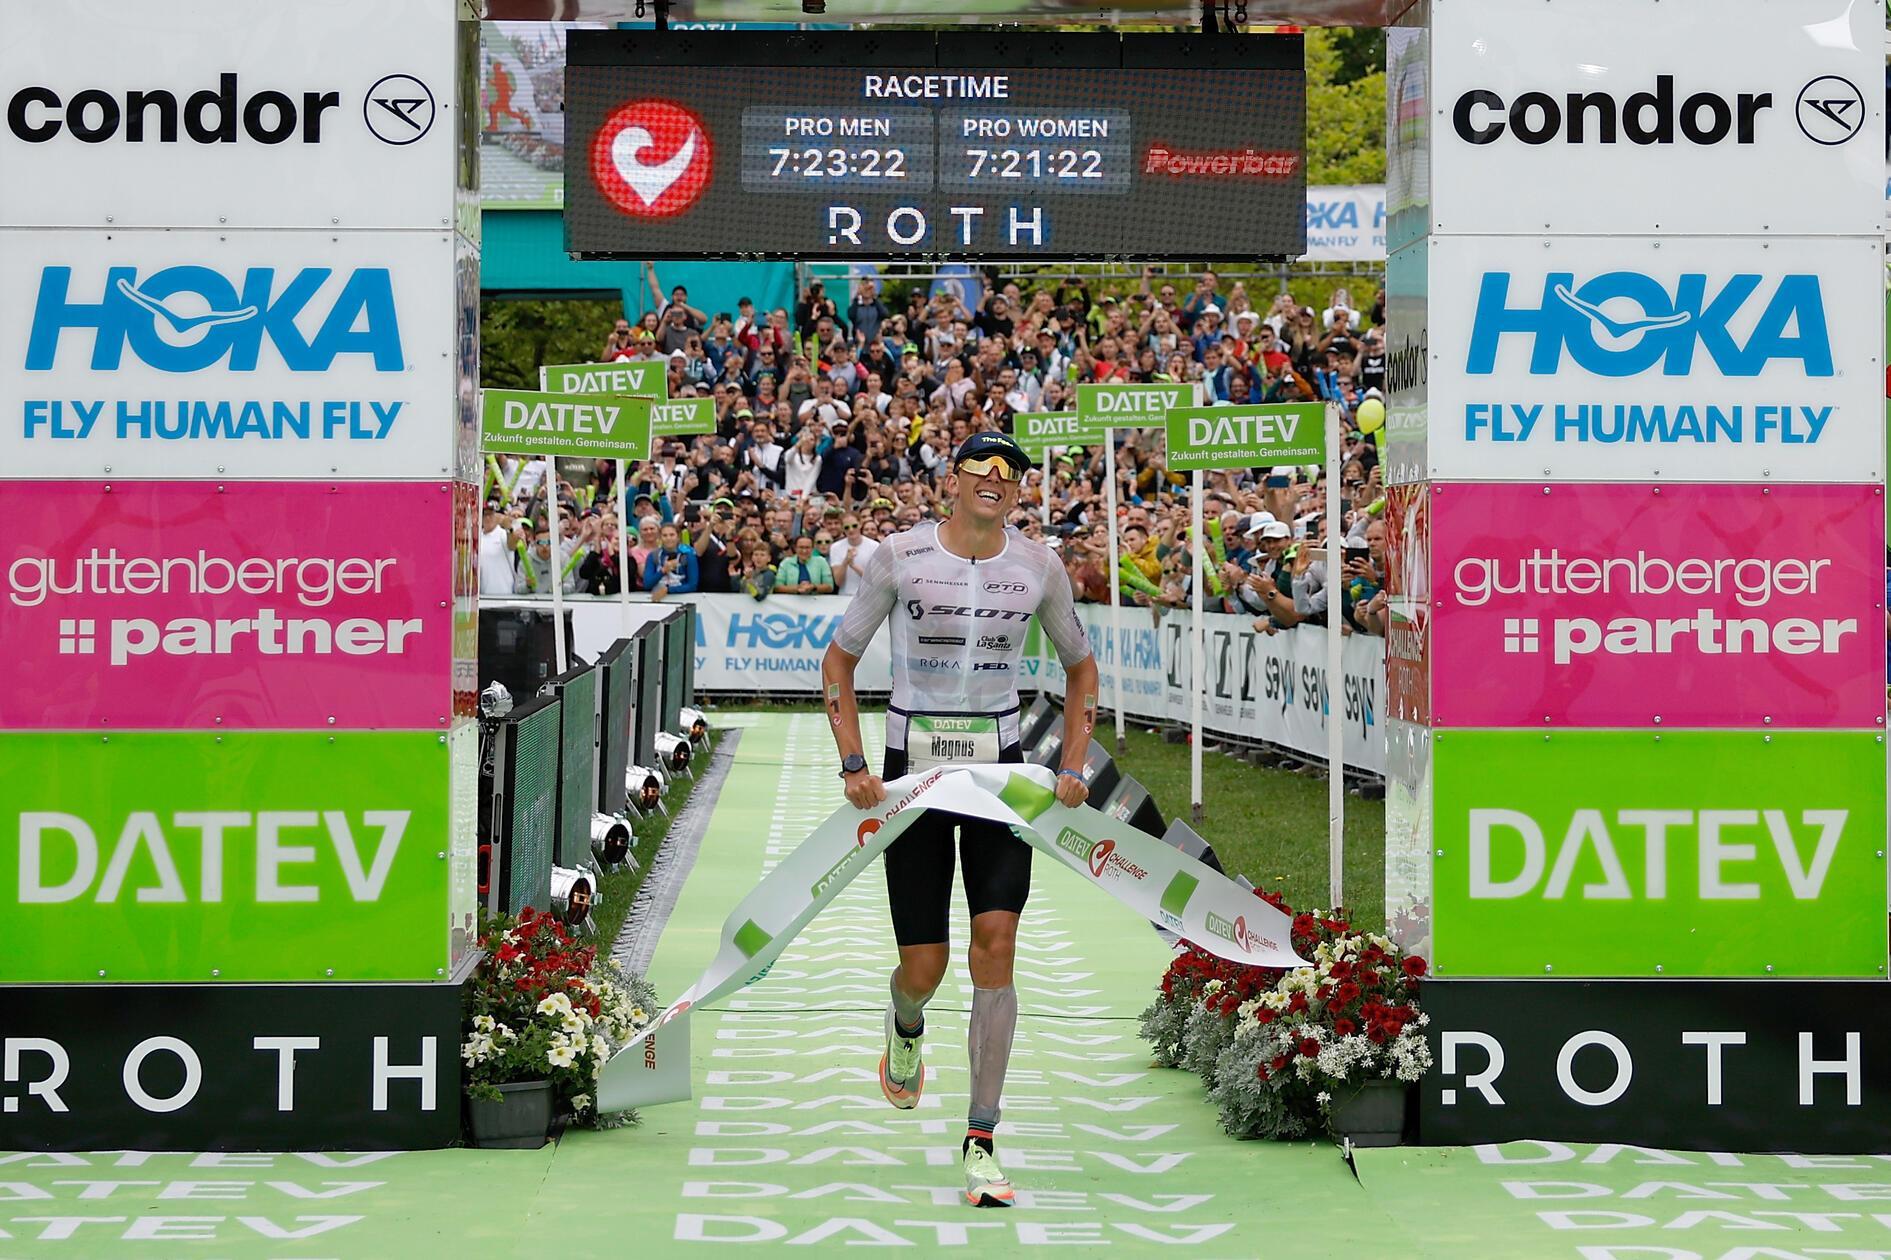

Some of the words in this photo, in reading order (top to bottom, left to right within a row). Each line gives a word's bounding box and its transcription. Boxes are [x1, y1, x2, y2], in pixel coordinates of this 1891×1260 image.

[865, 76, 1009, 98] RACETIME
[6, 73, 340, 145] condor
[1453, 75, 1772, 145] condor
[786, 118, 833, 136] PRO
[840, 119, 890, 136] MEN
[964, 120, 1010, 137] PRO
[1018, 120, 1108, 137] WOMEN
[769, 149, 905, 177] 7:23:22
[967, 150, 1102, 178] 7:21:22
[1146, 149, 1298, 175] Powerbar
[829, 207, 1042, 245] ROTH
[24, 265, 405, 373] HOKA
[1466, 271, 1835, 377] HOKA
[563, 369, 645, 394] DATEV
[1096, 392, 1179, 412] DATEV
[24, 401, 104, 439] FLY
[116, 401, 310, 439] HUMAN
[323, 401, 402, 439] FLY
[503, 400, 621, 434] DATEV
[1188, 414, 1300, 446] DATEV
[1465, 404, 1543, 443] FLY
[1555, 404, 1742, 444] HUMAN
[1755, 406, 1833, 444] FLY
[483, 432, 523, 444] Zukunft
[525, 434, 575, 447] gestalten.
[576, 437, 639, 450] Gemeinsam.
[1171, 450, 1209, 461] Zukunft
[1211, 448, 1258, 460] gestalten.
[1260, 446, 1320, 458] Gemeinsam.
[906, 546, 935, 558] FUSION
[8, 548, 397, 607] guttenberger
[986, 583, 1026, 592] PTO
[1454, 549, 1831, 607] guttenberger
[928, 605, 1033, 622] SCOTT
[110, 609, 423, 666] partner
[1554, 608, 1858, 665] partner
[726, 658, 751, 671] FLY
[756, 659, 820, 672] HUMAN
[933, 719, 972, 730] DATEV
[931, 735, 975, 761] Magnus
[18, 810, 412, 904] DATEV
[1061, 829, 1091, 858] DATEV
[1469, 808, 1849, 900] DATEV
[1109, 853, 1149, 881] CHALLENGE
[3, 1036, 438, 1112] ROTH
[1441, 1030, 1861, 1106] ROTH
[687, 1146, 1197, 1173] DATEV
[680, 1180, 1217, 1213] DATEV
[0, 1215, 367, 1240] TEV
[672, 1213, 1239, 1246] DATEV
[1536, 1210, 1891, 1232] DAT
